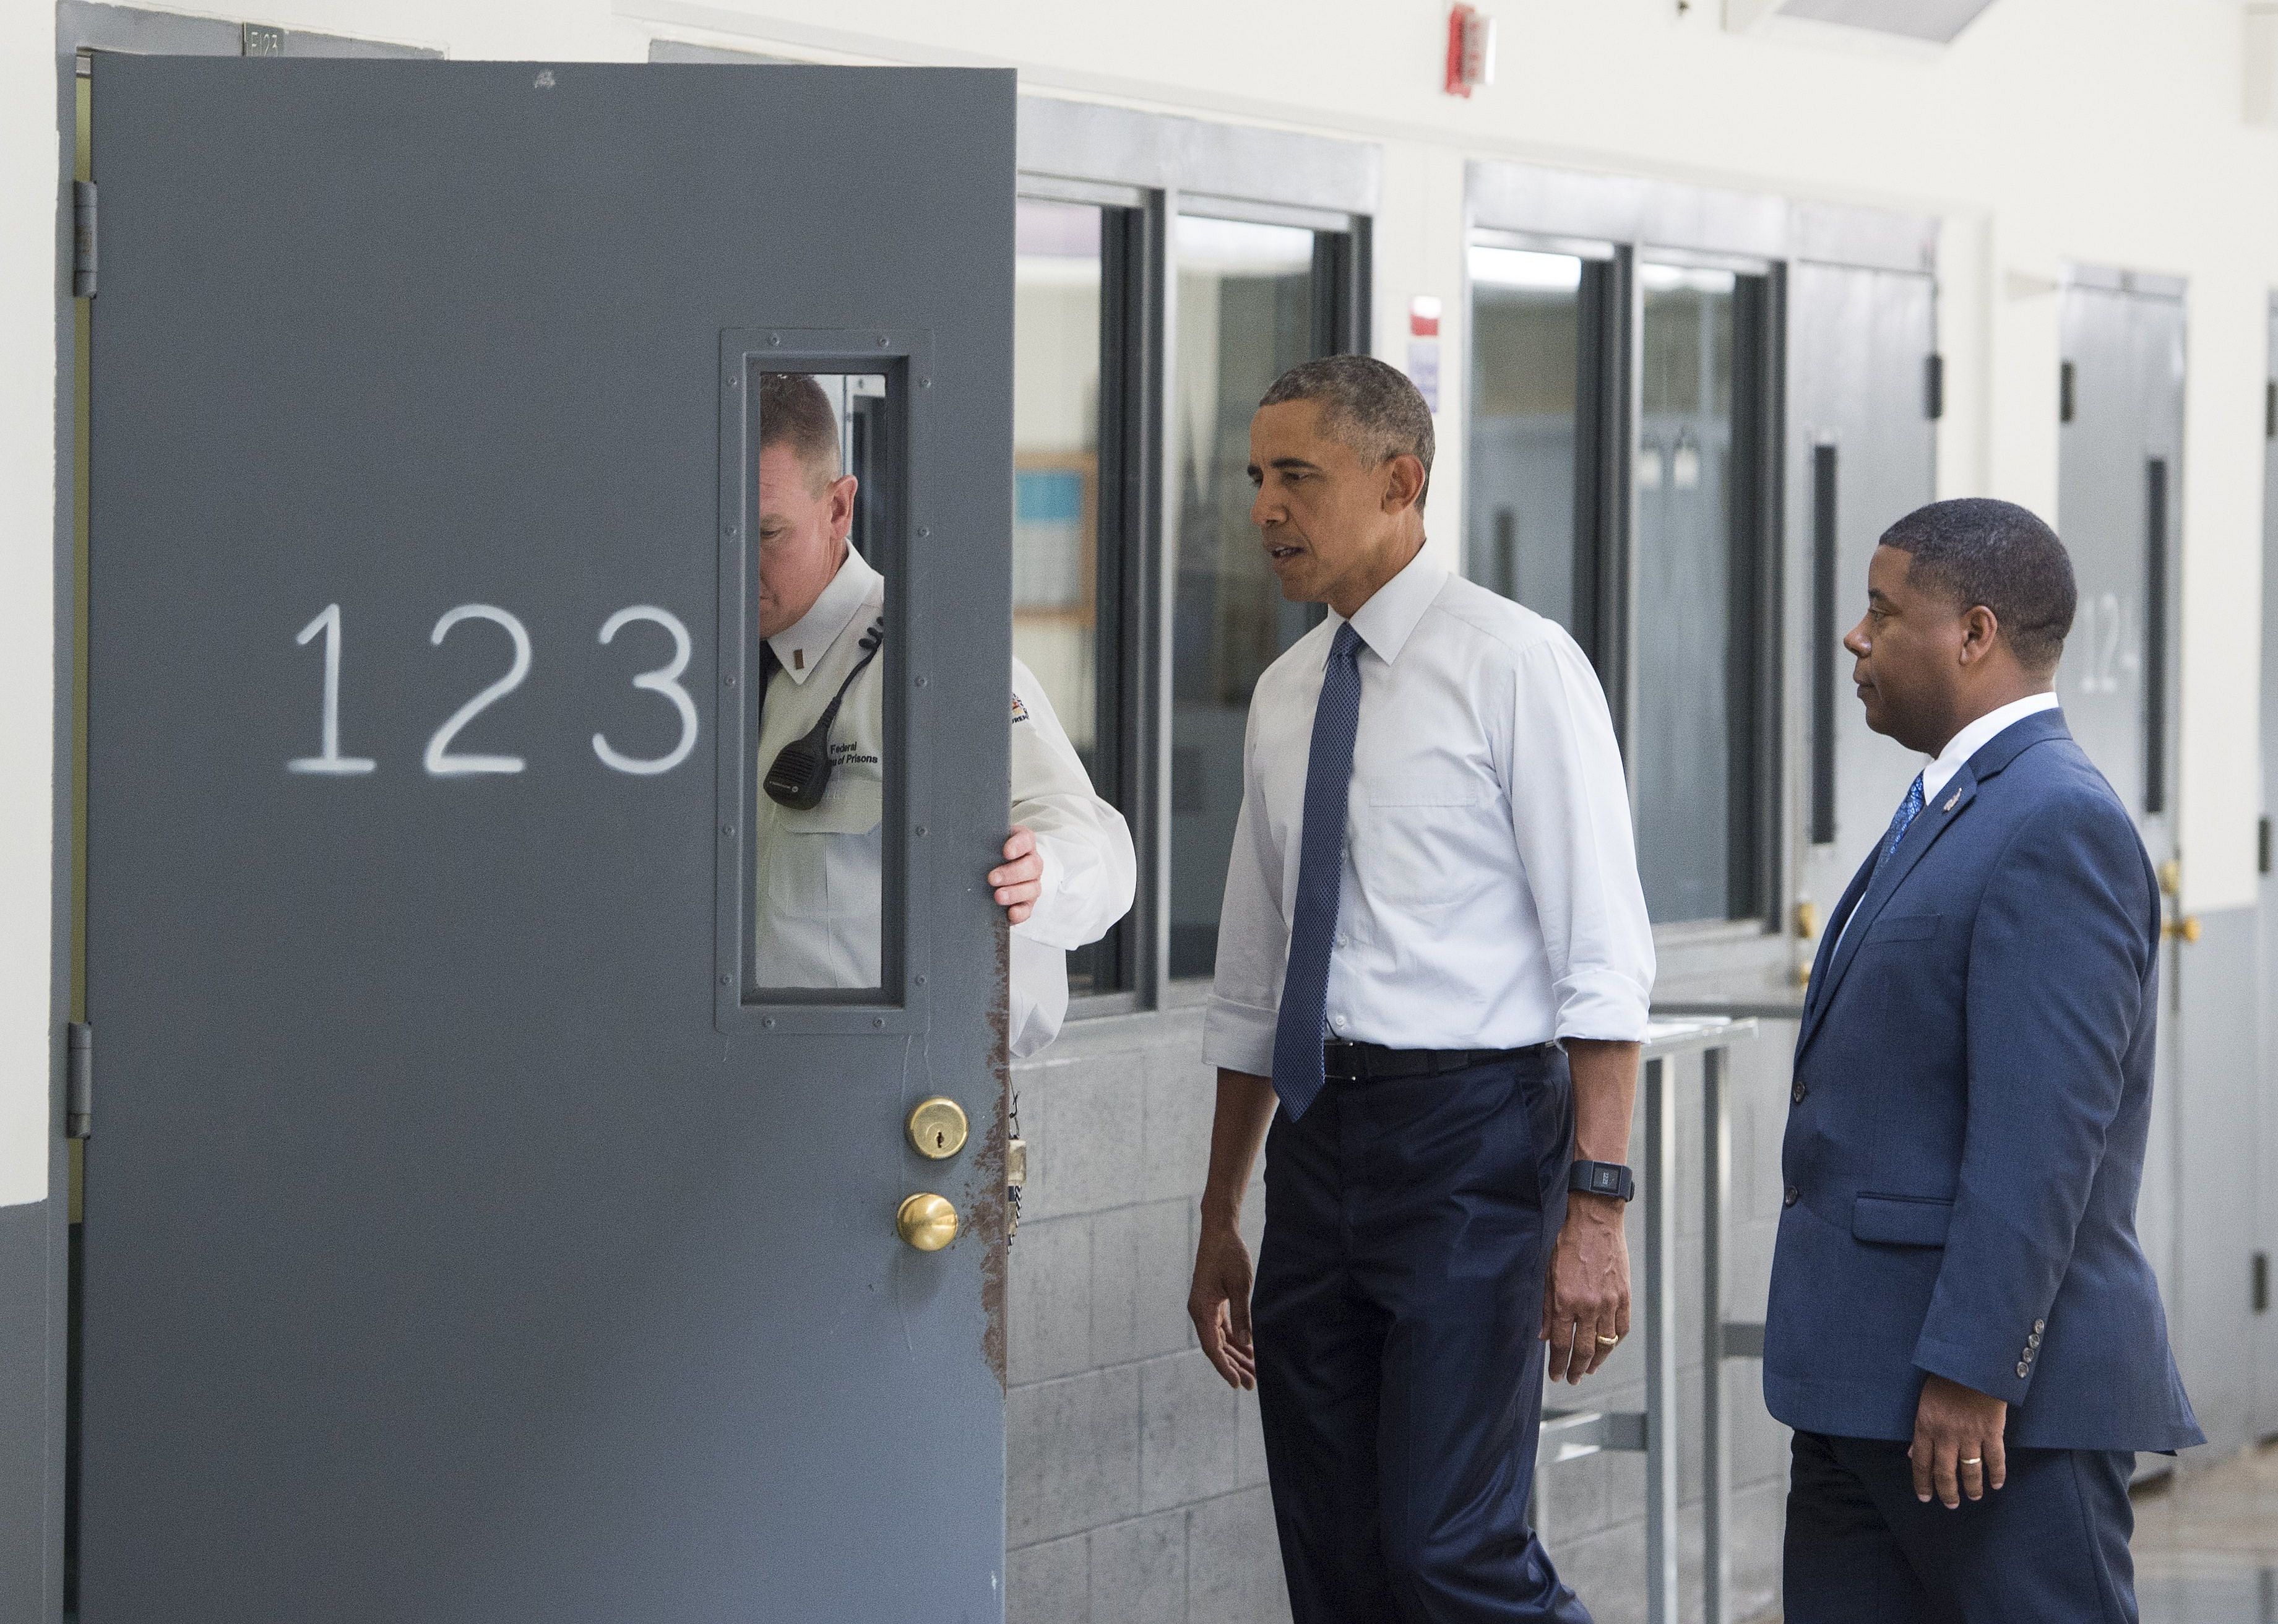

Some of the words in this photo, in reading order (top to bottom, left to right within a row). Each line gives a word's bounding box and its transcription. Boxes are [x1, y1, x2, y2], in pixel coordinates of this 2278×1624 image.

[287, 603, 699, 776] 123
[830, 741, 857, 754] Federal
[837, 755, 845, 766] of
[846, 753, 878, 764] Prisons
